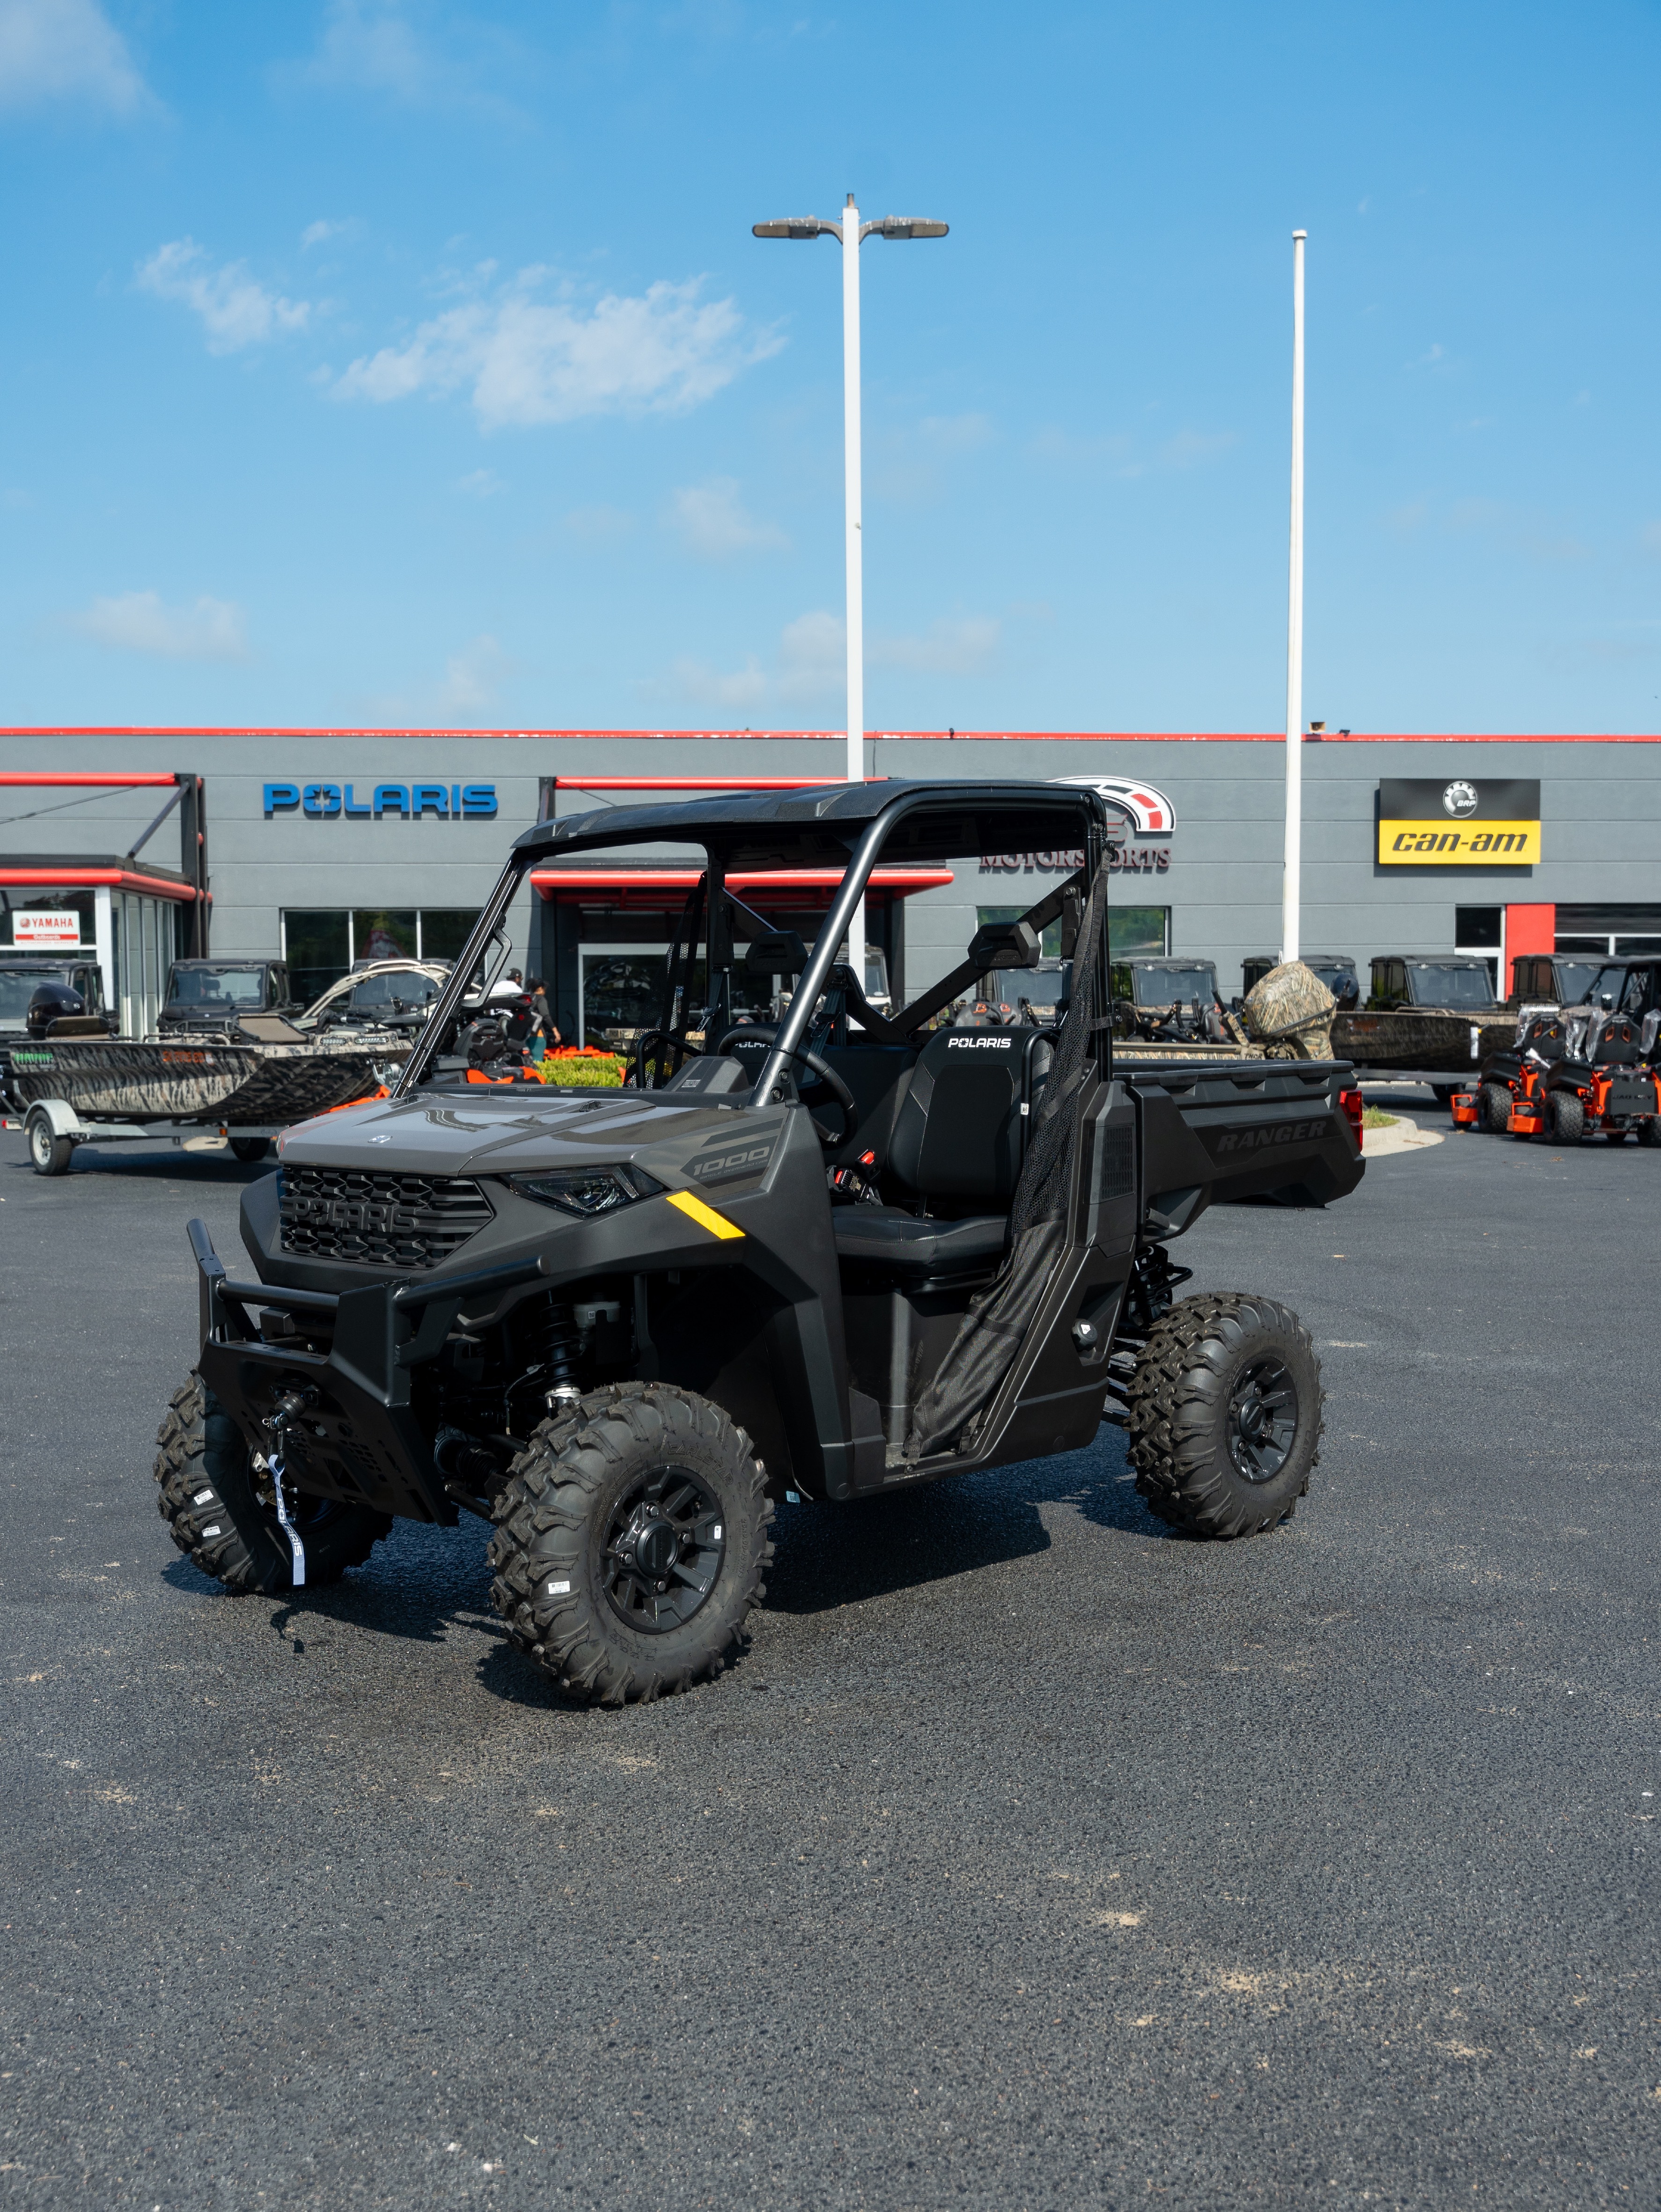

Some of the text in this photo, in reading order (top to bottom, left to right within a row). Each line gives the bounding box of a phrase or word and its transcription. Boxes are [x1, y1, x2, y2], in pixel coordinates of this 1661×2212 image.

[263, 784, 498, 813] POLARIS
[1393, 834, 1528, 852] can-am
[980, 848, 1172, 868] MOTORSORTS
[32, 918, 73, 928] YAMAHA
[948, 1038, 1011, 1048] POLARIS
[15, 1053, 54, 1064] HAVOC
[1216, 1121, 1326, 1152] RANGER
[693, 1146, 770, 1176] 1000
[700, 1171, 722, 1179] SINGLE
[724, 1163, 754, 1173] OVERHEAD
[292, 1196, 419, 1233] POLARIS
[278, 1498, 302, 1556] POLARIS
